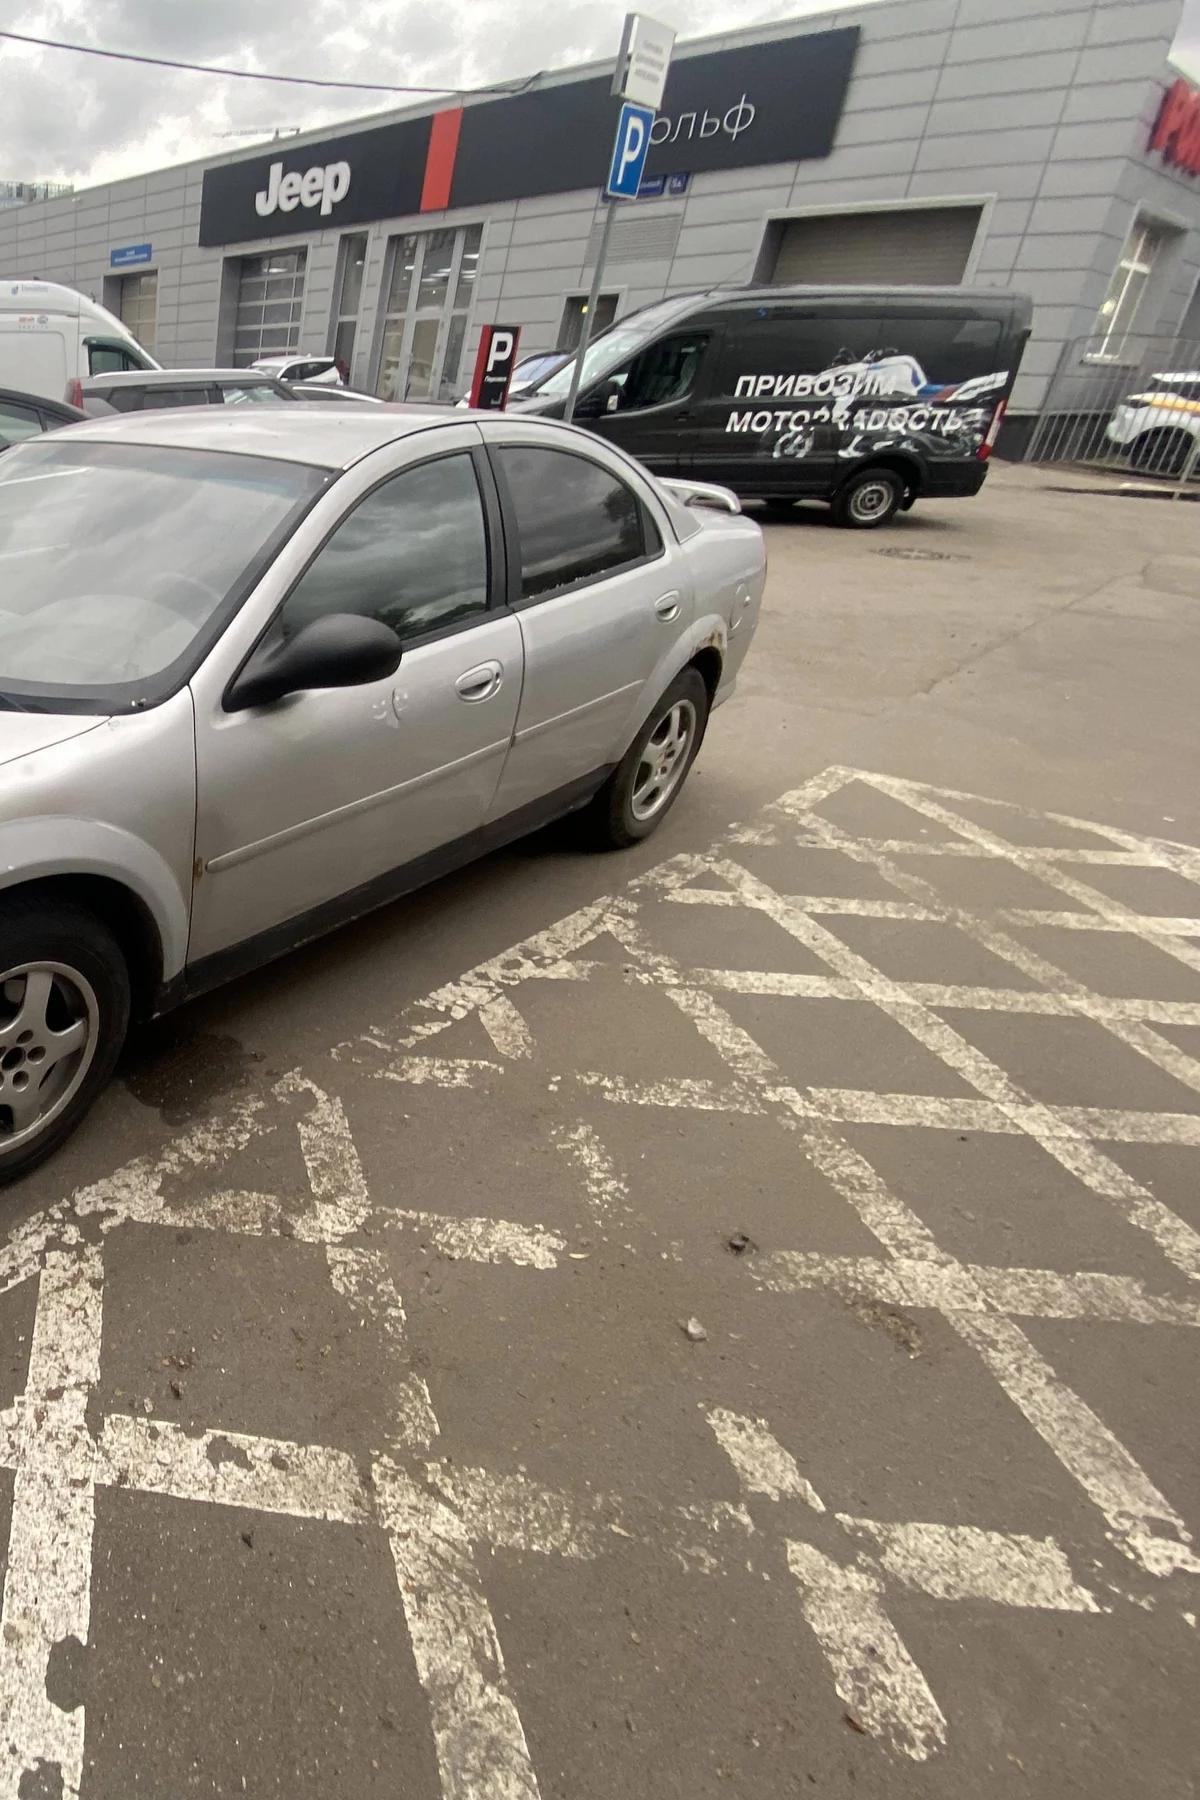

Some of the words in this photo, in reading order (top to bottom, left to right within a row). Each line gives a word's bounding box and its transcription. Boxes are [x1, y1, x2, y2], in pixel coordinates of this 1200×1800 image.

[650, 93, 756, 145] ольф
[255, 161, 351, 216] Jeep
[486, 332, 513, 372] P
[734, 374, 897, 397] ПРИВОЗИМ
